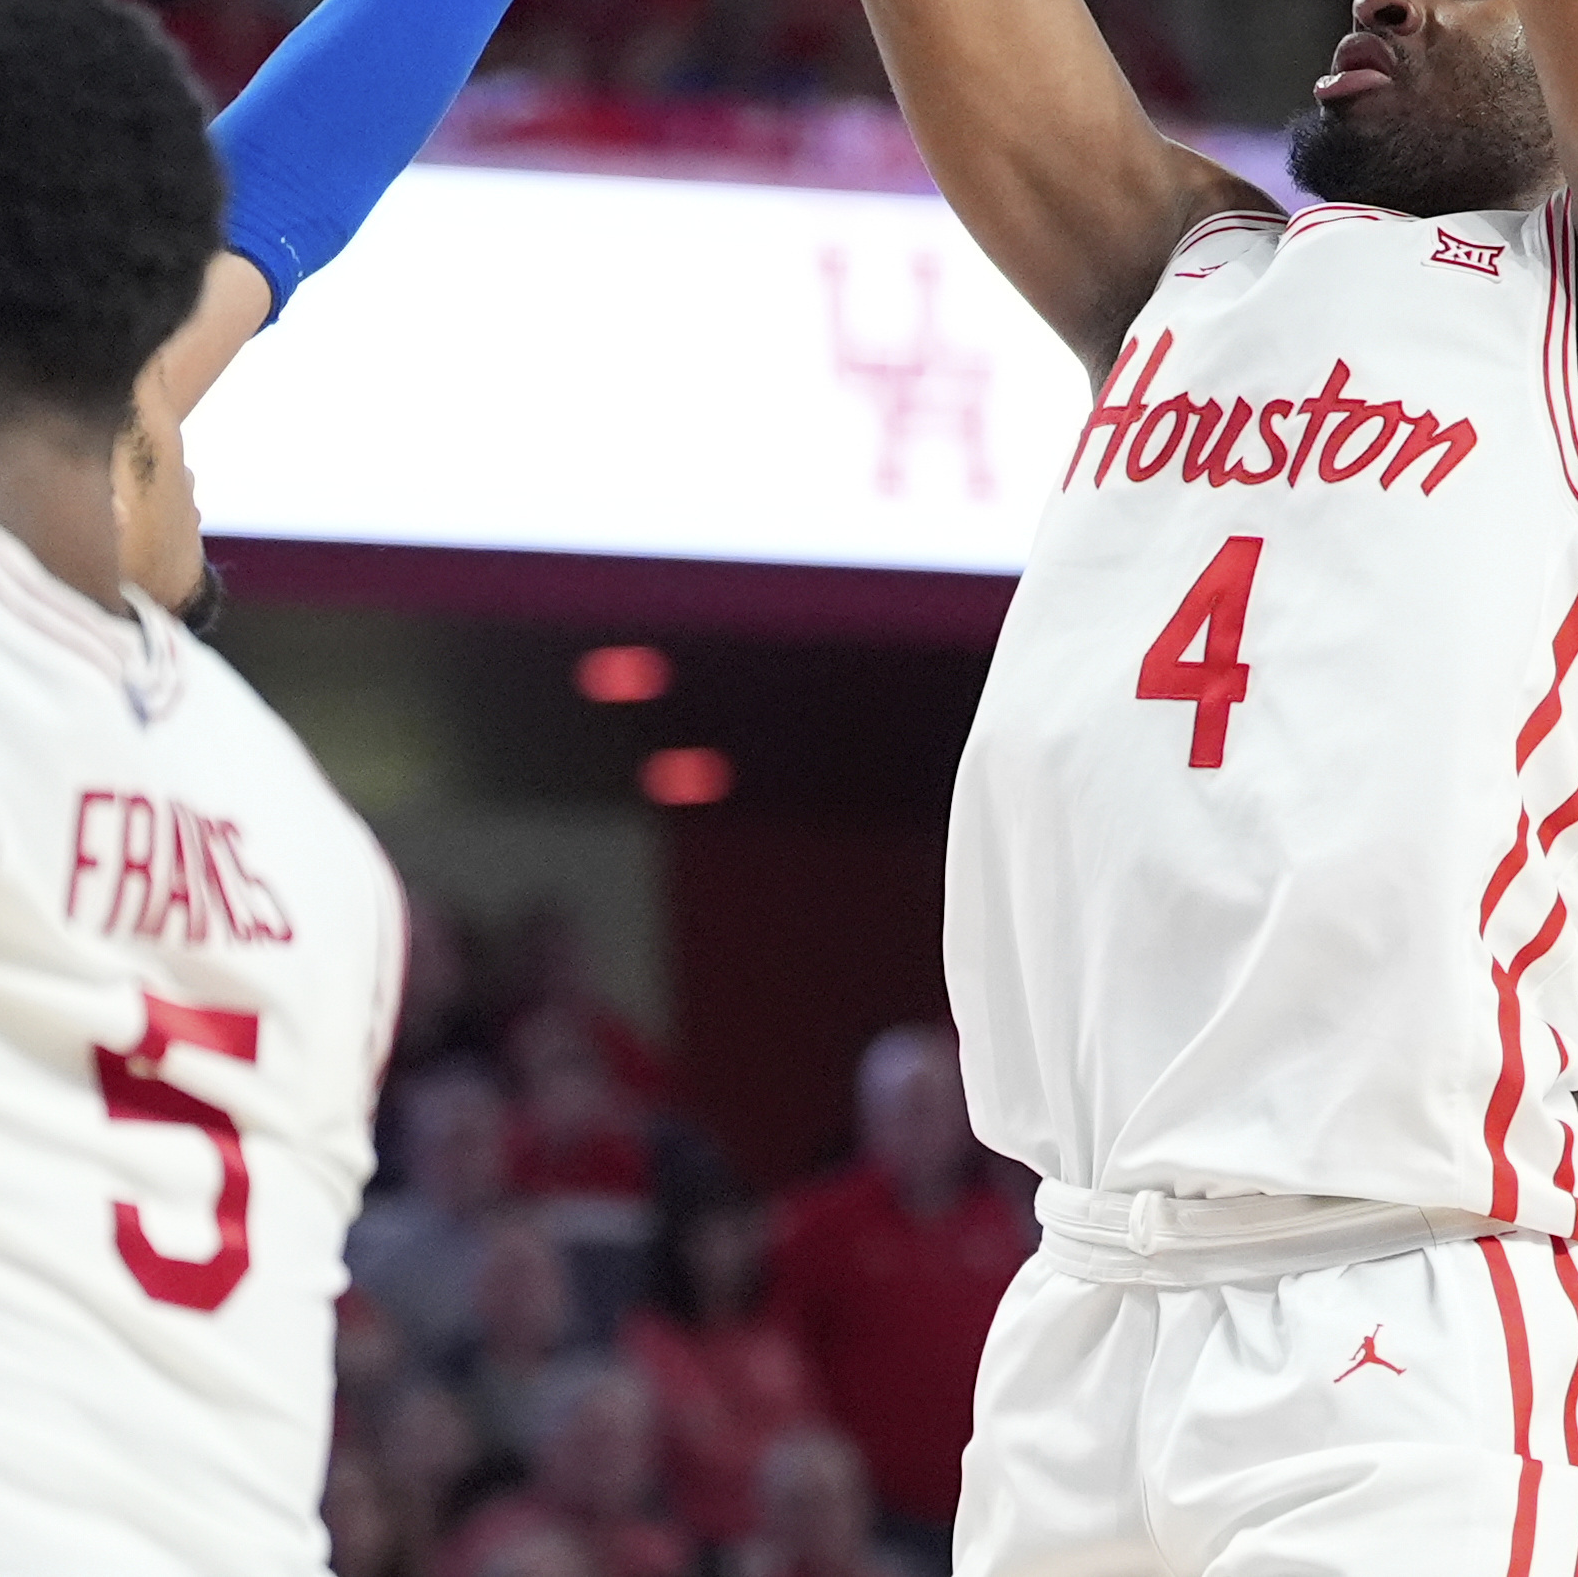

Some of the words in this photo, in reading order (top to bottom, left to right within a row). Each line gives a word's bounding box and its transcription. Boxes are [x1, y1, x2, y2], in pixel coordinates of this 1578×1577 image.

[1062, 326, 1478, 496] Houston
[1135, 535, 1264, 769] 4
[94, 992, 259, 1315] 5
